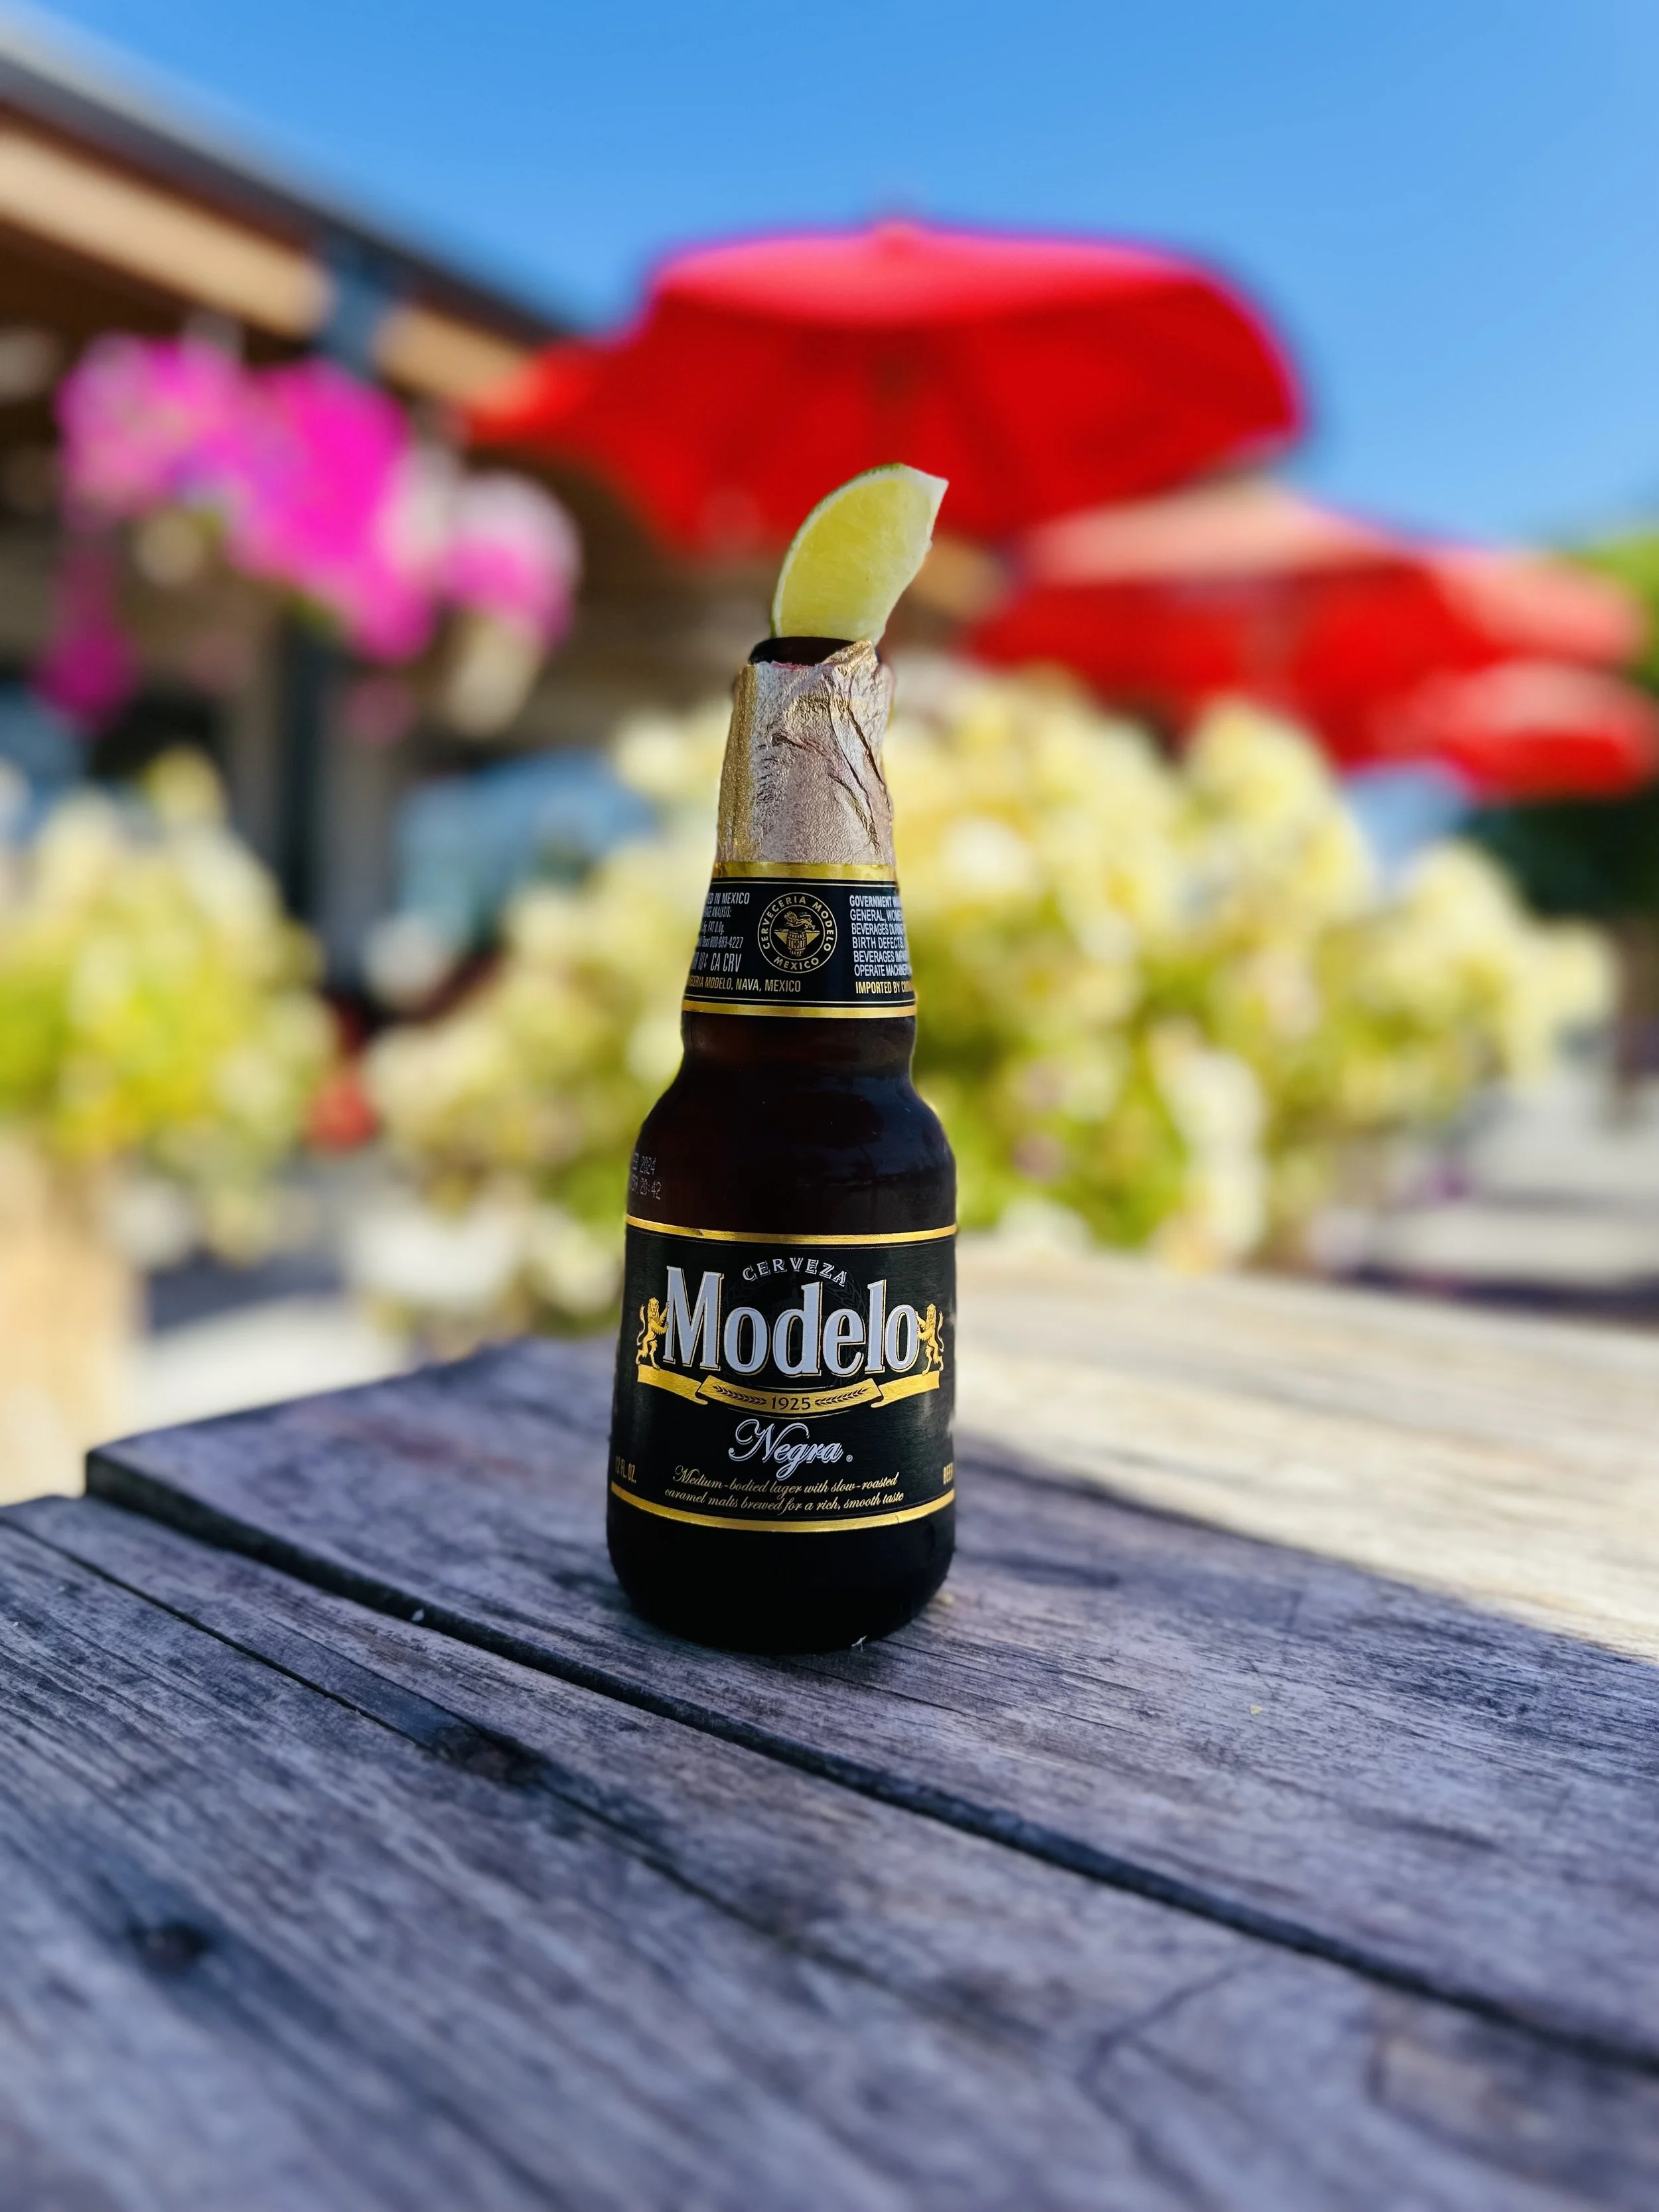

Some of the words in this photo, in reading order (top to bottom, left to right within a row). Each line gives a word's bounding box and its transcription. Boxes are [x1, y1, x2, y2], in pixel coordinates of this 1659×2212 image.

[714, 893, 721, 904] IN
[721, 892, 750, 904] MEXICO
[849, 895, 892, 908] GOVERNMENT
[850, 909, 887, 923] GENERAL,
[886, 910, 903, 921] WOME
[760, 895, 806, 950] CERVECERIA
[812, 901, 834, 952] MODELO
[851, 922, 889, 936] BEVERAGES
[852, 936, 876, 949] BIRTH
[710, 952, 721, 971] CA
[723, 952, 742, 972] CRV
[773, 956, 820, 970] MEXICO
[853, 950, 895, 963] BEVERAGES
[854, 964, 886, 977] OPERATE
[735, 978, 762, 992] NAVA,
[764, 979, 801, 992] MEXICO
[855, 981, 892, 994] IMPORTED
[893, 981, 901, 994] BY
[742, 1257, 847, 1287] CERVEZA
[663, 1265, 920, 1378] Modelo
[770, 1396, 811, 1410] 1925
[728, 1418, 844, 1481] Negra
[672, 1465, 770, 1493] Medium-bodied
[769, 1480, 802, 1501] lager
[804, 1479, 830, 1493] with
[830, 1471, 900, 1493] slow-roasted
[665, 1488, 708, 1504] caramel
[707, 1495, 739, 1508] malts
[741, 1496, 786, 1511] brewed
[777, 1497, 803, 1516] for
[804, 1502, 814, 1511] a
[816, 1496, 841, 1511] rich,
[843, 1491, 881, 1509] smooth
[882, 1491, 904, 1505] taste
